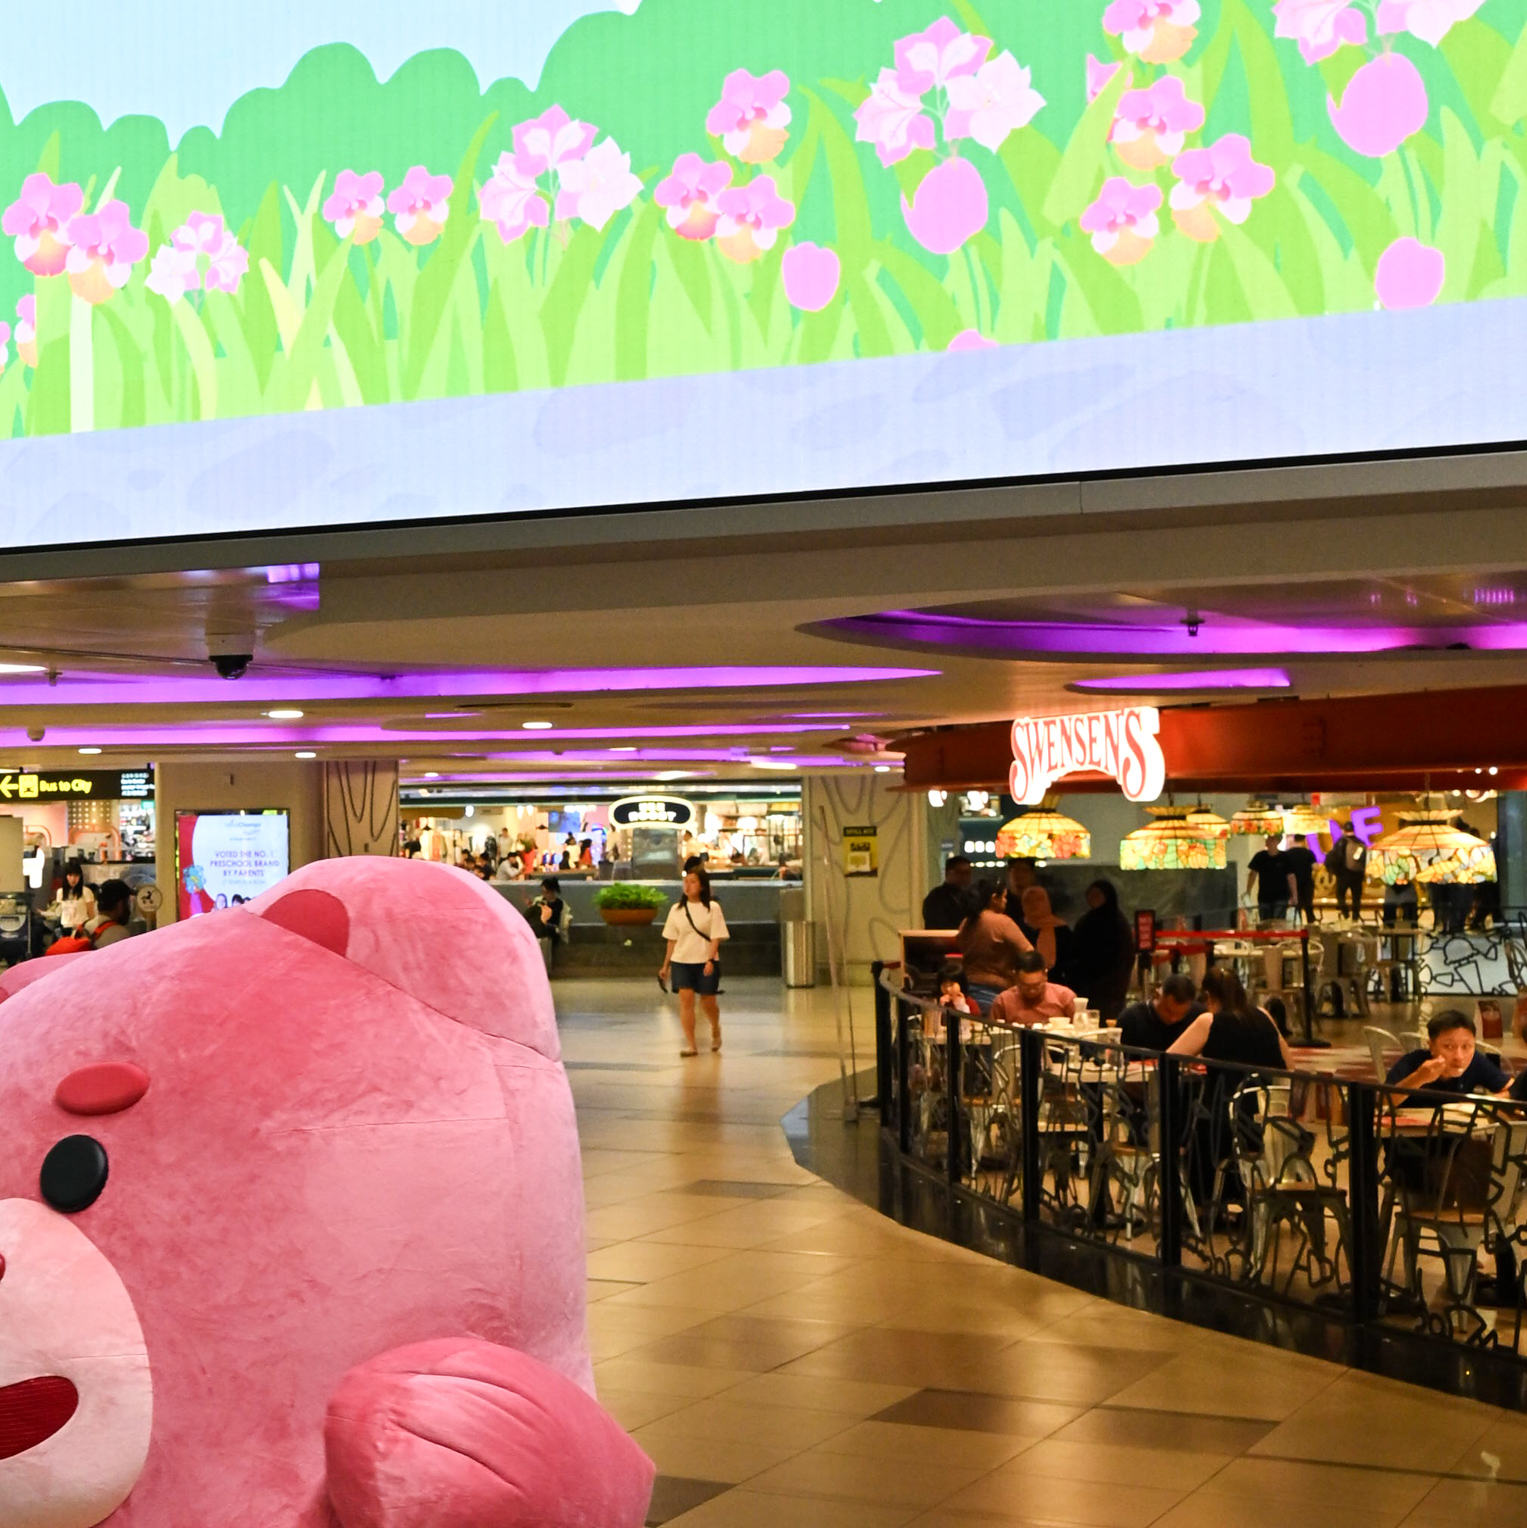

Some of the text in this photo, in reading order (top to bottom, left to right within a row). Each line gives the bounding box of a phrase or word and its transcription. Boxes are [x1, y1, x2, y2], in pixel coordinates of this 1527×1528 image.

[40, 778, 93, 794] Bus to City
[215, 850, 239, 858] VOTED
[240, 850, 252, 858] THE
[210, 860, 280, 868] PRESCHOOL BRAND
[223, 869, 265, 877] BY PARENTS
